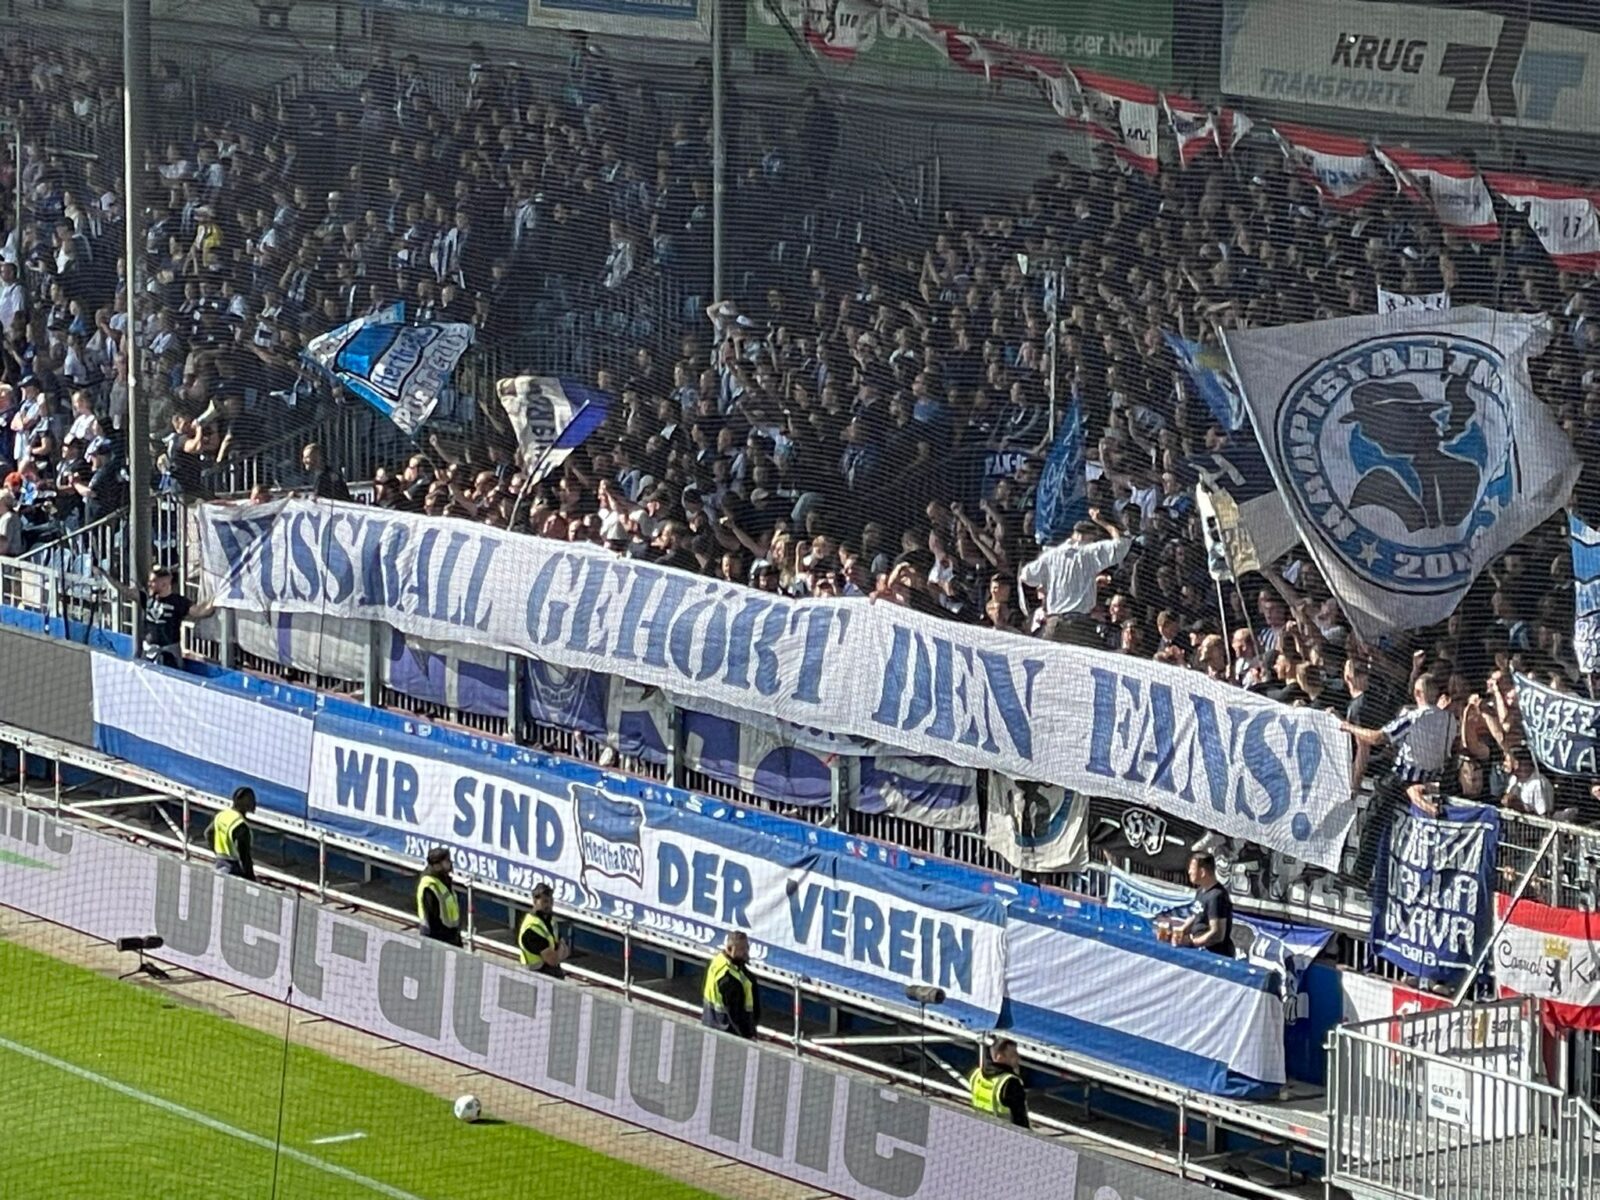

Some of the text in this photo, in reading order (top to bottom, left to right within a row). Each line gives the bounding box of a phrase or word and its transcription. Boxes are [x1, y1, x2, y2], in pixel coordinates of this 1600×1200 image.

[1027, 25, 1067, 51] Fülle
[1075, 31, 1104, 54] der
[1109, 31, 1164, 58] Natur
[1332, 33, 1427, 74] KRUG
[1259, 67, 1416, 102] TRANSPORTE
[212, 511, 501, 632] FUSSBALL
[525, 553, 850, 704] GEHÖRT
[872, 624, 1045, 761] DEN
[1085, 667, 1321, 842] FANS!
[335, 746, 564, 862] WIR SIND
[584, 835, 641, 877] Hertha BSC
[657, 841, 973, 995] DER VEREIN
[1499, 940, 1543, 976] Casual
